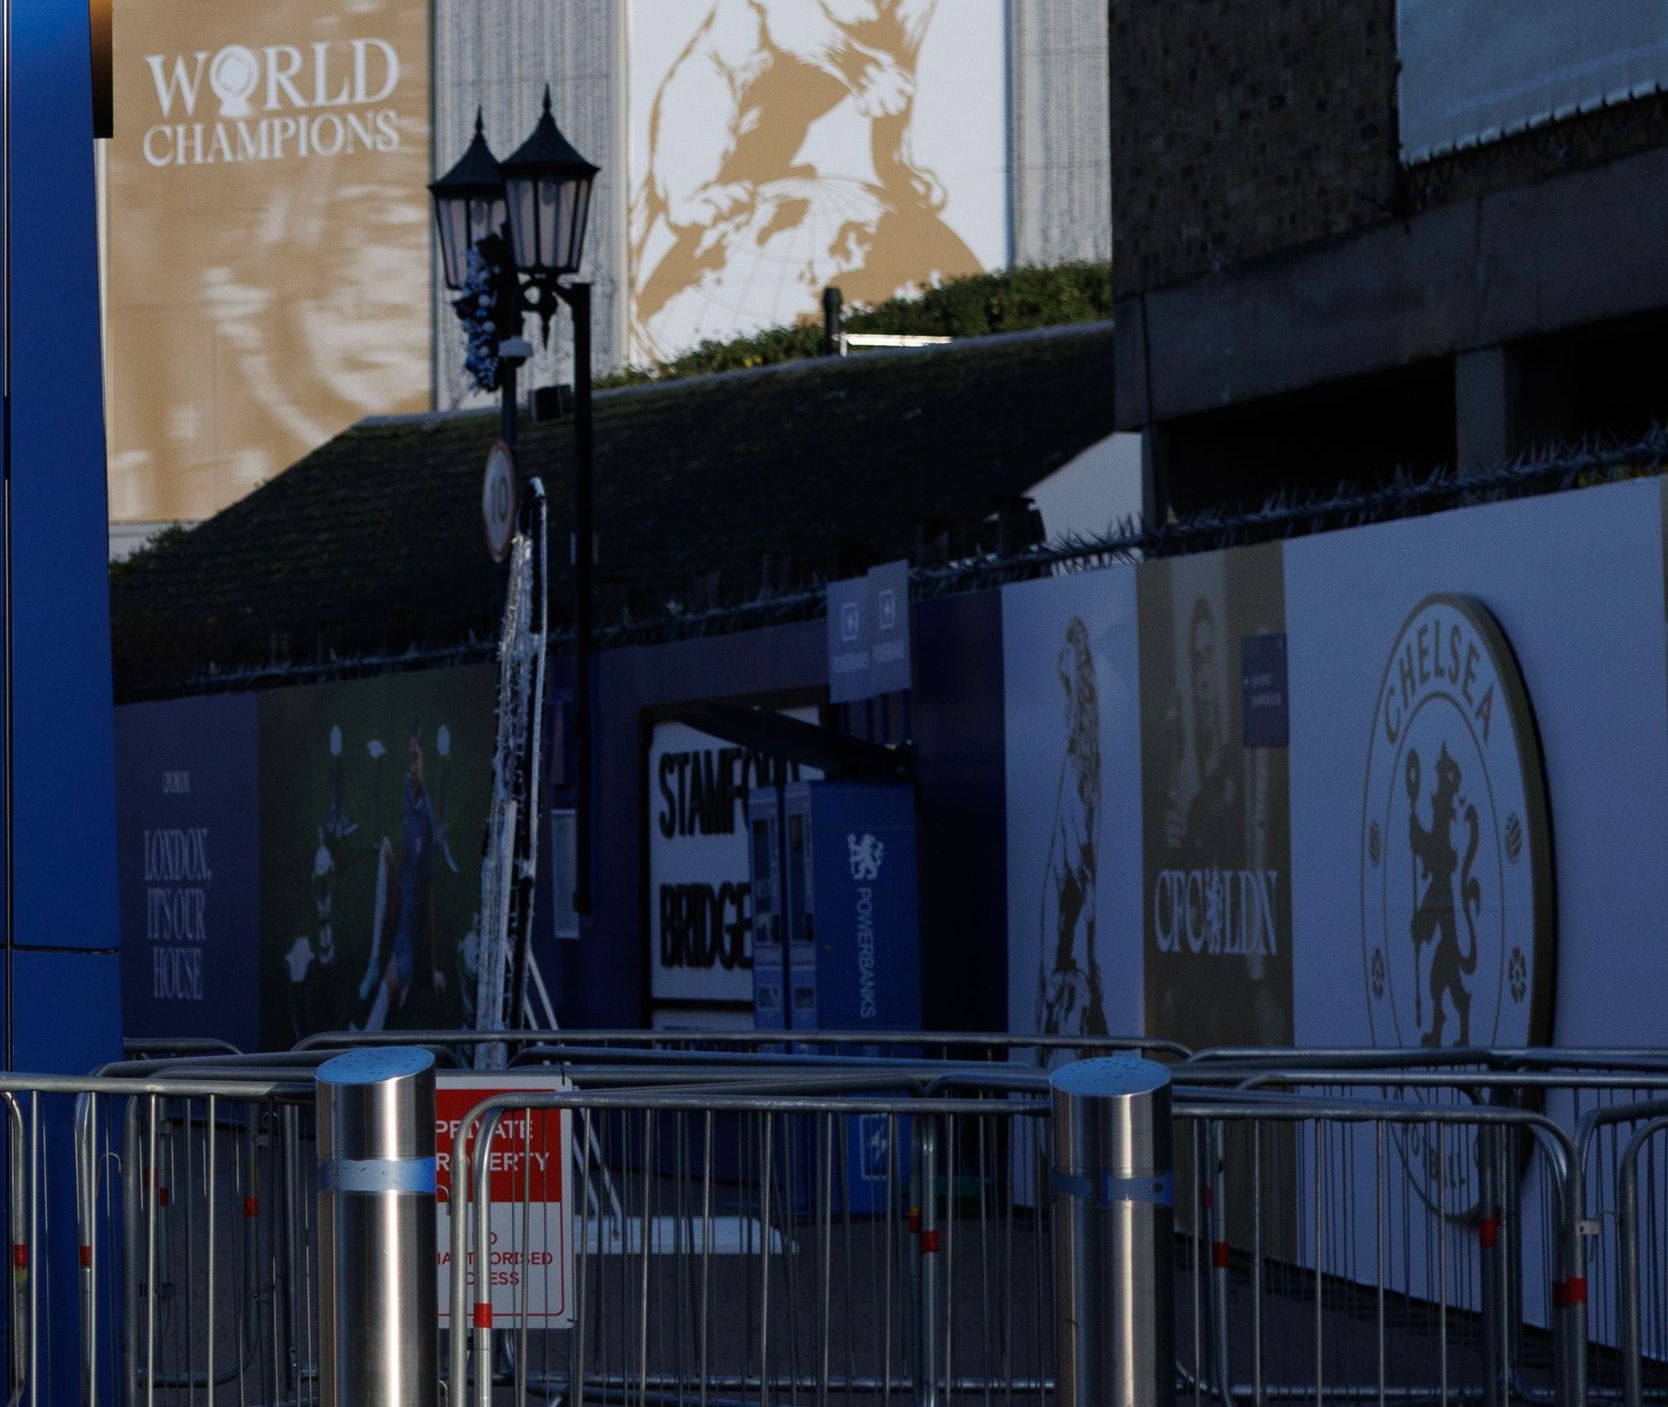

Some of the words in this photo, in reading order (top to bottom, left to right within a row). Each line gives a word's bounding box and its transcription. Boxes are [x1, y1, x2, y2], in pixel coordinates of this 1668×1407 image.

[144, 36, 401, 119] WORLD
[142, 108, 401, 169] CHAMPIONS
[1385, 619, 1495, 745] CHELSEA
[660, 744, 799, 839] STAMF
[659, 881, 753, 971] BRIDGE
[855, 885, 878, 1021] POWERBANKS
[152, 946, 205, 1001] HOUSE
[435, 1120, 535, 1140] PRIATE
